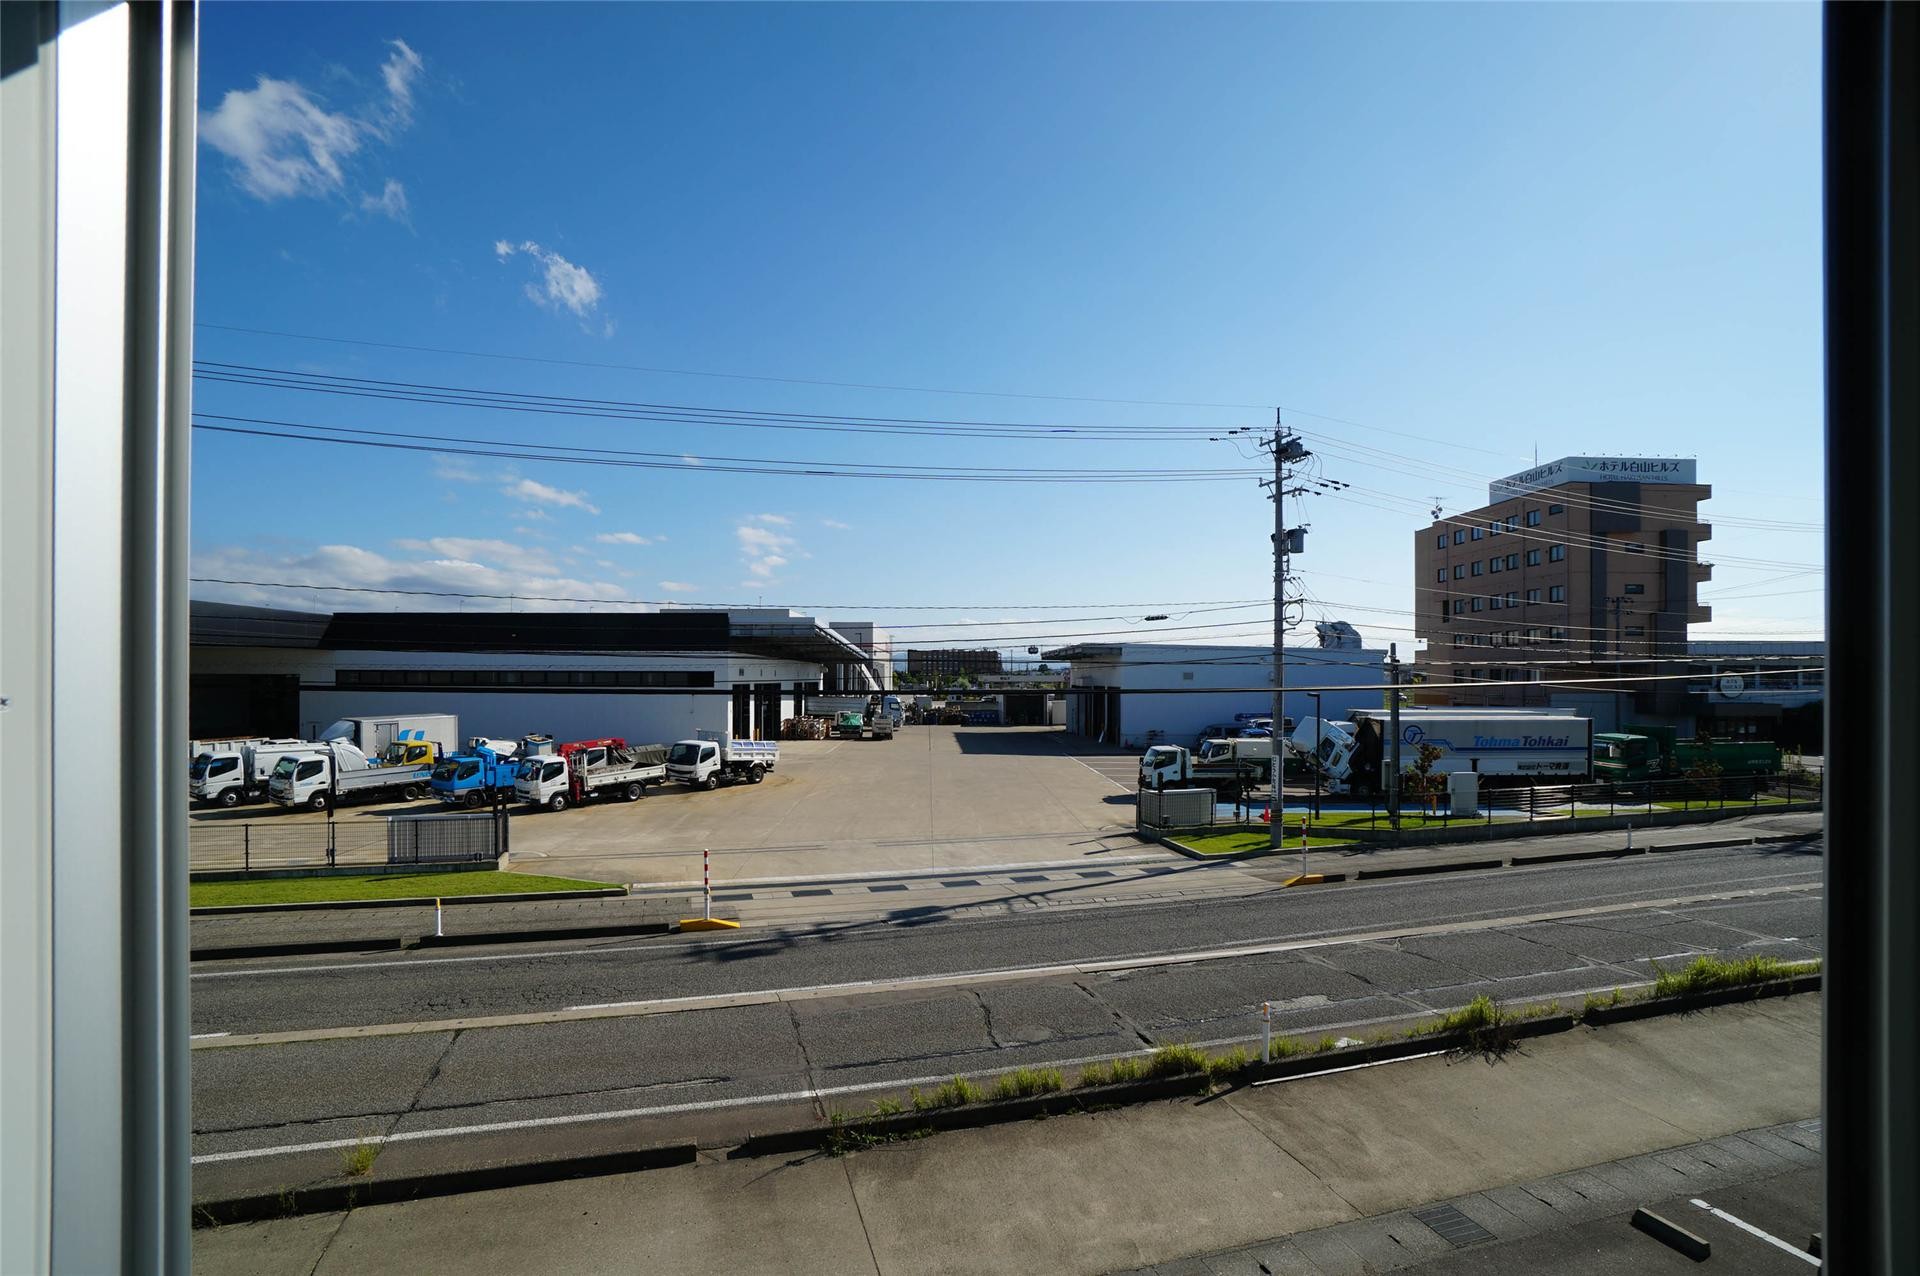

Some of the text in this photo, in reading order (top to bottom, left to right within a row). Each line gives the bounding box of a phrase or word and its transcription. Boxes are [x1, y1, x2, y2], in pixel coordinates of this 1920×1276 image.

[1599, 461, 1680, 473] ホテル白山ヒルズ
[1473, 735, 1569, 747] Tohma Tohkai
